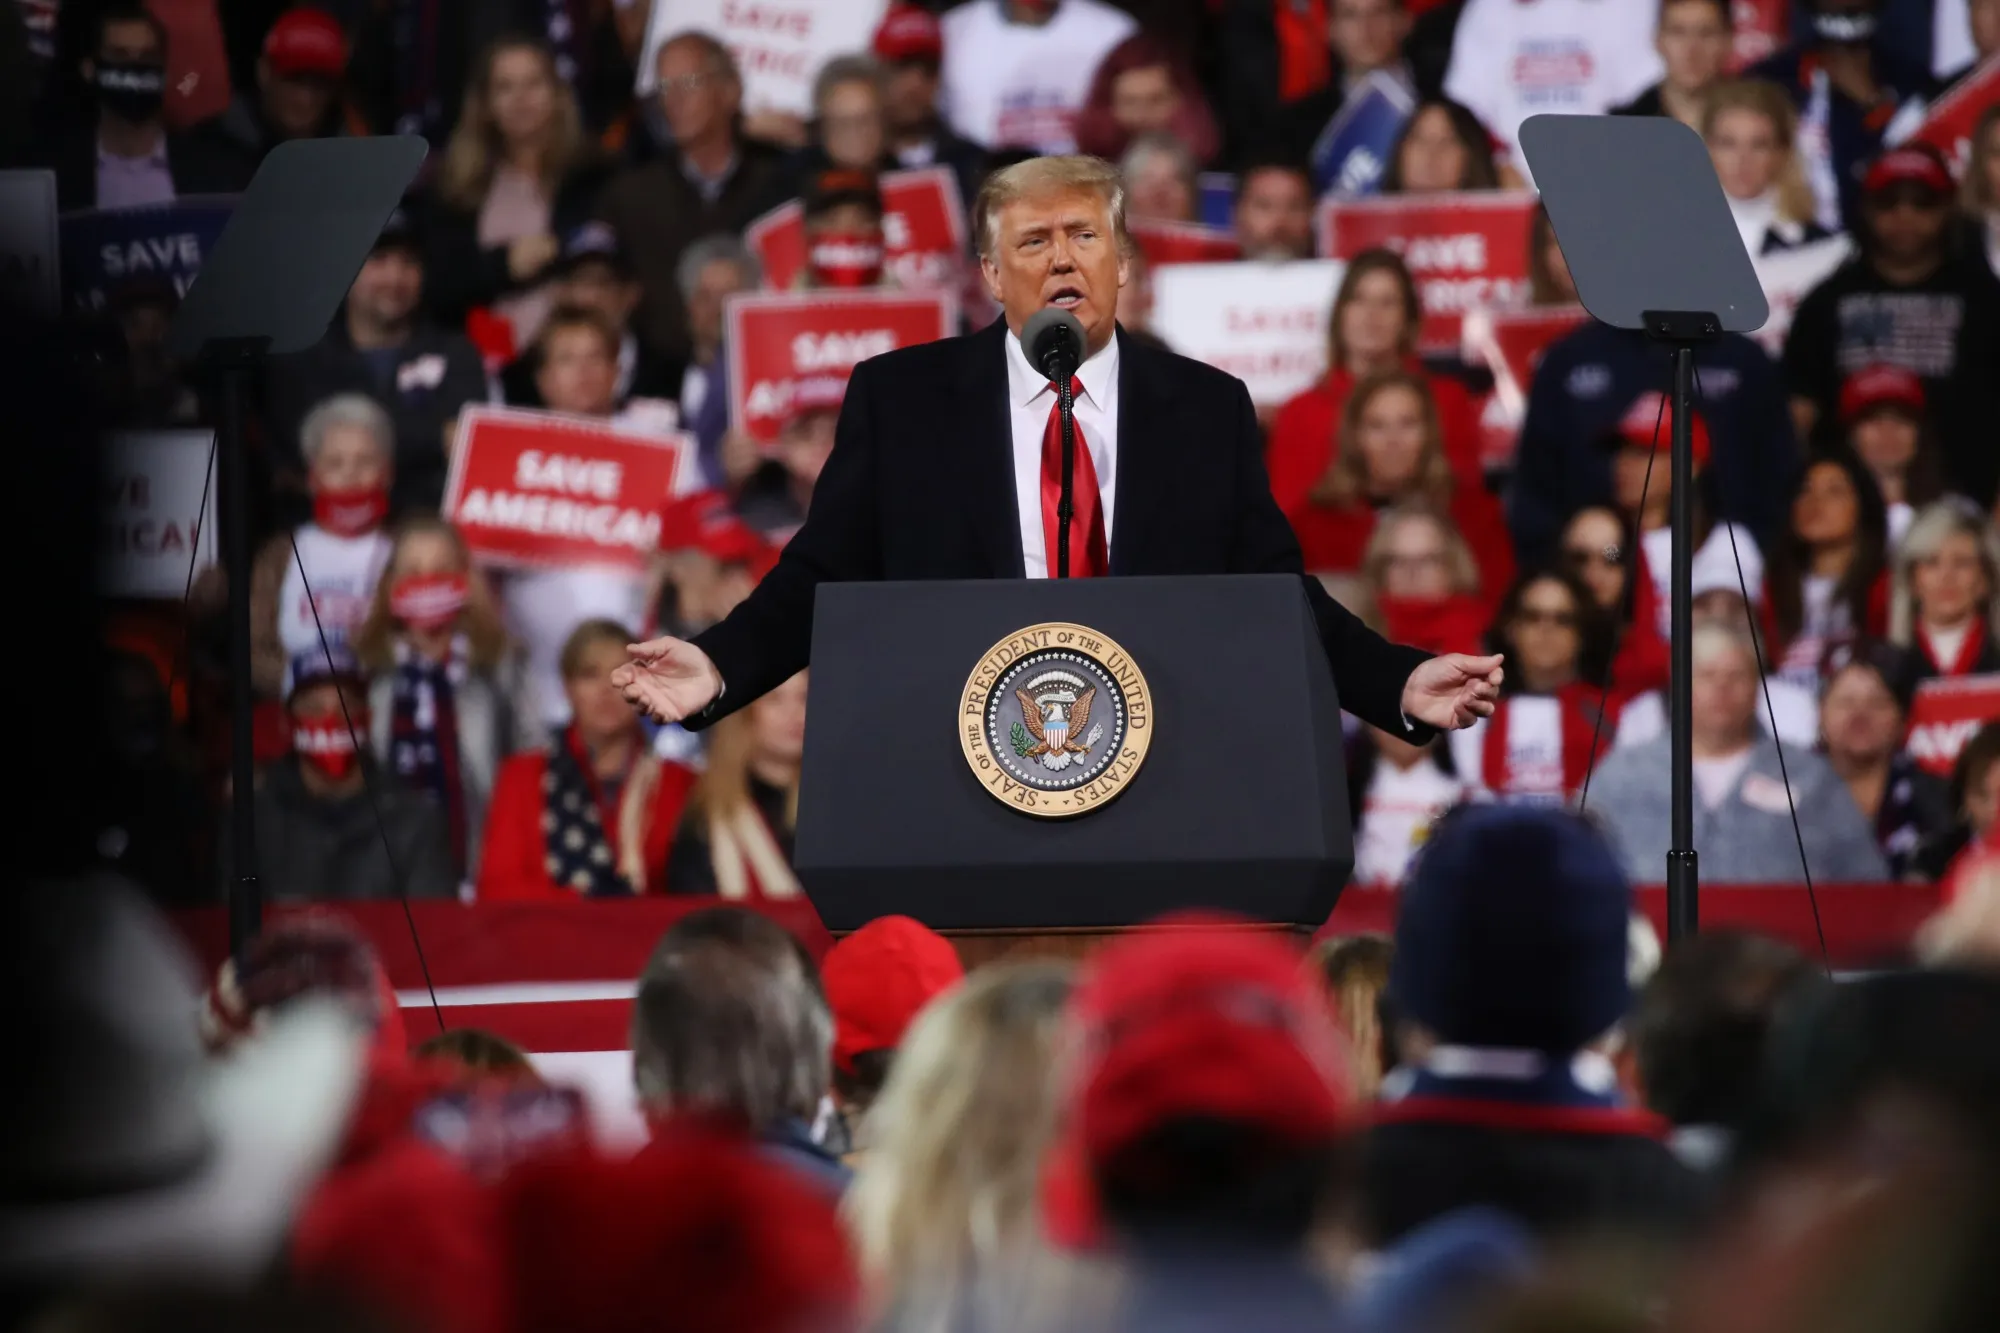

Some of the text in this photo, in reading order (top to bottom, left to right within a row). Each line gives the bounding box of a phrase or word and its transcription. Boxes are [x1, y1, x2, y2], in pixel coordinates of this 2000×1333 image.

[100, 232, 200, 277] SAVE
[514, 449, 624, 500] SAVE
[966, 630, 1147, 806] SEAL OF THE PRESIDENT OF THE UNITED STATES
